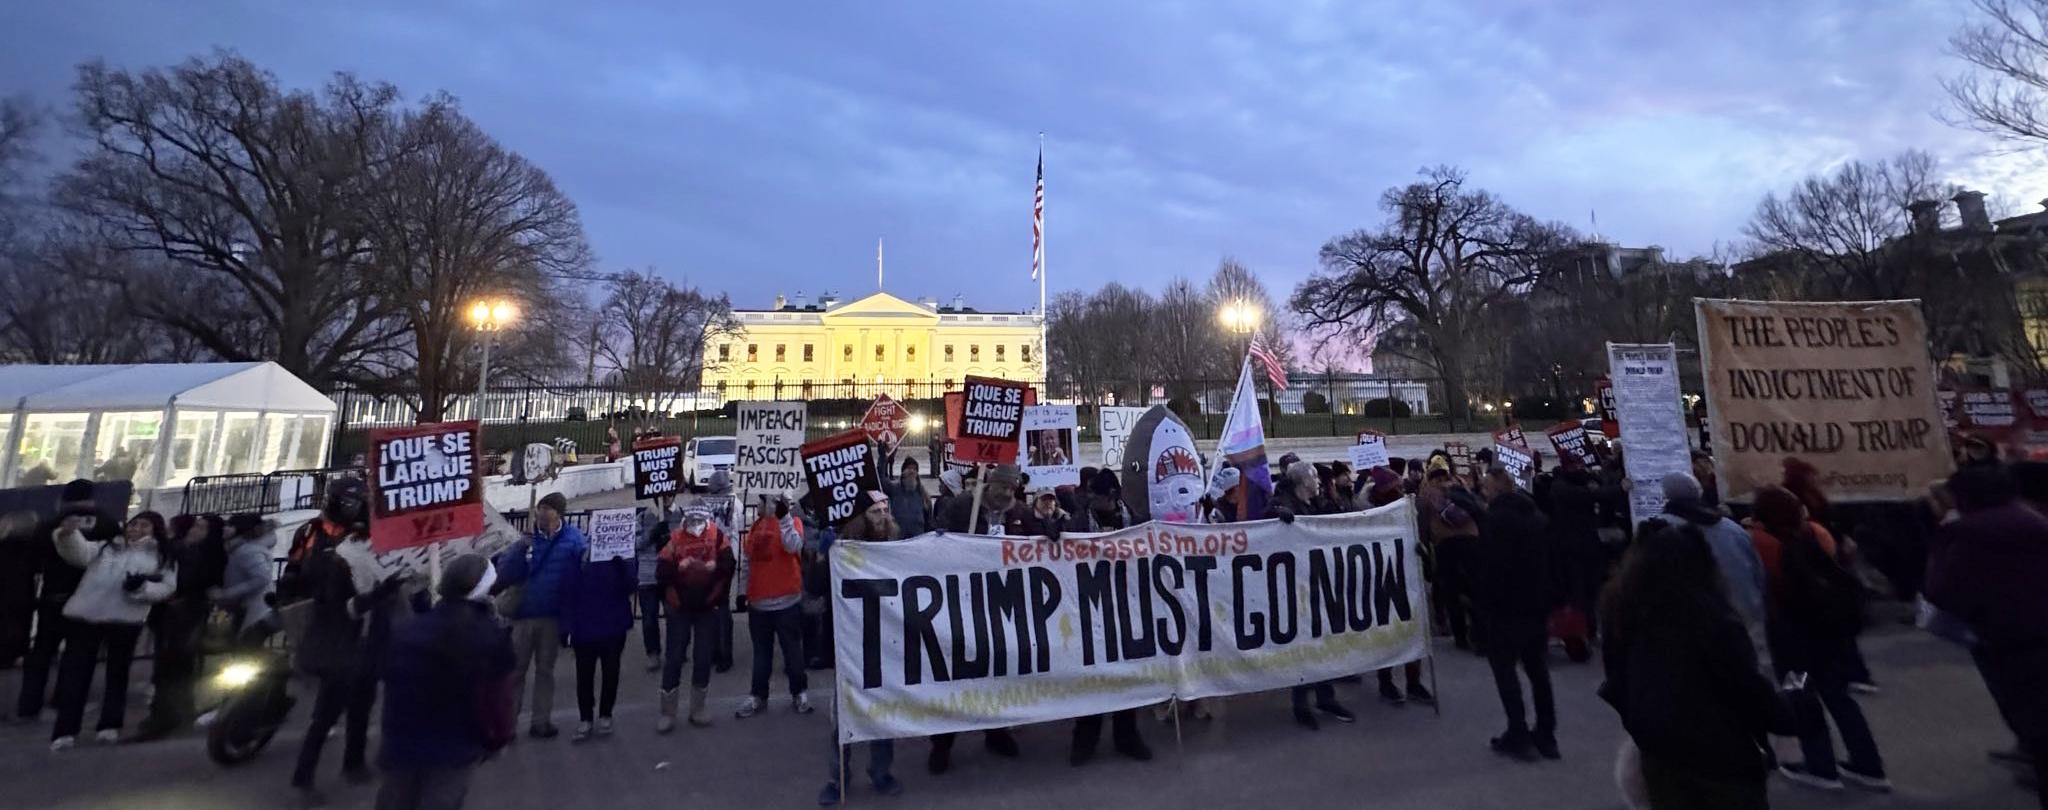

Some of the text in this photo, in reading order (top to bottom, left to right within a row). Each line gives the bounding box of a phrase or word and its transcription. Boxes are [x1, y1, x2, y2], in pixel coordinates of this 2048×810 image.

[1724, 316, 1899, 348] THE PEOPLE'S
[1727, 366, 1916, 400] INDICTMENT OF
[968, 384, 1021, 404] ¡QUE SE
[741, 410, 803, 431] IMPEACH
[874, 405, 896, 416] FIGHT
[965, 401, 1019, 421] LARGUE
[966, 419, 1014, 438] TRUMP
[1550, 427, 1584, 443] TRUMP
[1729, 421, 1845, 453] DONALD
[1849, 418, 1931, 452] TRUMP
[380, 431, 471, 464] ¡QUE SE
[757, 434, 781, 445] THE
[635, 446, 679, 461] TRUMP
[738, 445, 799, 467] FASCIST
[806, 443, 868, 472] TRUMP
[1496, 443, 1531, 463] TRUMP
[1498, 453, 1528, 471] MUST
[641, 458, 676, 473] MUST
[816, 461, 865, 488] MUST
[1505, 465, 1520, 476] GO
[650, 470, 668, 482] GO
[736, 470, 800, 489] TRAITOR!
[384, 479, 470, 511] TRUMP
[644, 480, 677, 495] NOW!
[833, 482, 858, 501] GO
[841, 538, 1412, 689] TRUMP MUST GO NOW
